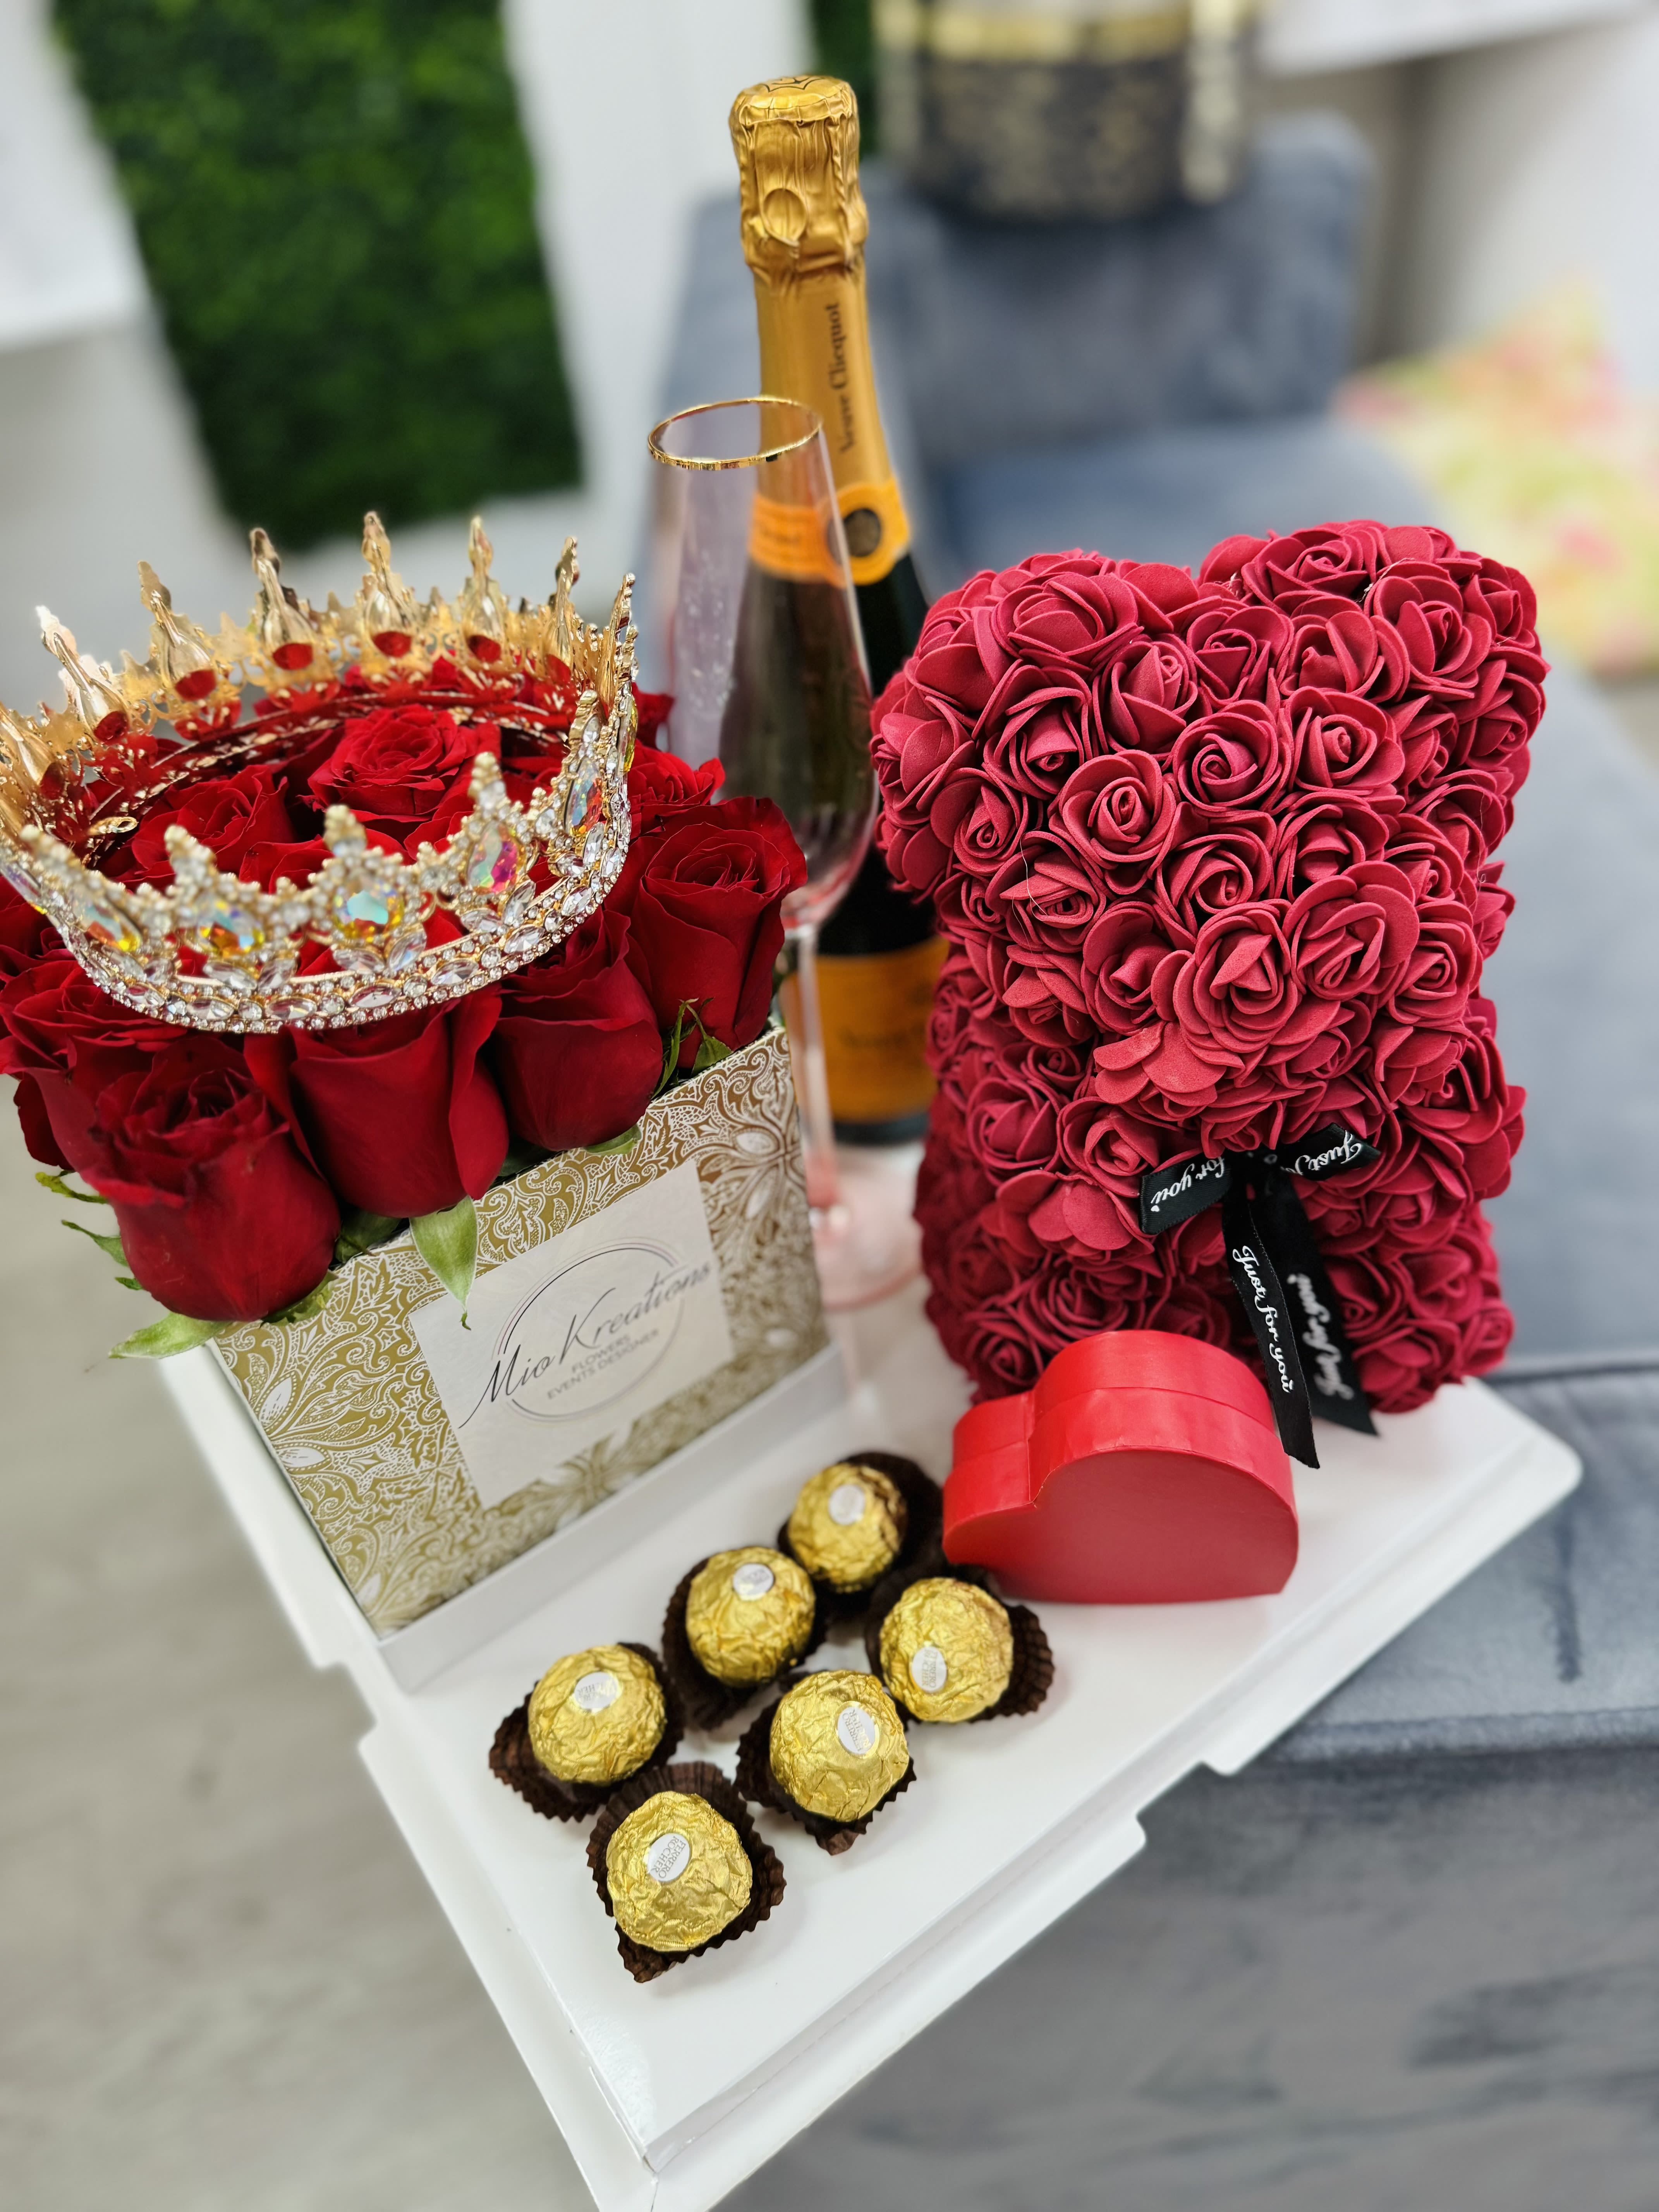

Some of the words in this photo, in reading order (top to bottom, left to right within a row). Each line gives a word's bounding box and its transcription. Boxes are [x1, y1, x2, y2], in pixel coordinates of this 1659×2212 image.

[825, 302, 848, 390] Clicquot
[1195, 1157, 1225, 1180] for
[1309, 1130, 1362, 1171] Just
[1151, 1163, 1195, 1204] you
[1232, 1245, 1267, 1298] Just
[1254, 1295, 1279, 1342] for
[1269, 1343, 1291, 1393] you
[458, 1344, 555, 1429] Mio
[559, 1262, 712, 1365] Kreations
[572, 1334, 631, 1373] FLOWERS
[1302, 1317, 1342, 1363] for
[547, 1365, 596, 1400] EVENTS
[598, 1329, 659, 1370] DESIGNER
[650, 1836, 679, 1873] ROCHER
[658, 1840, 686, 1878] FERRERO
